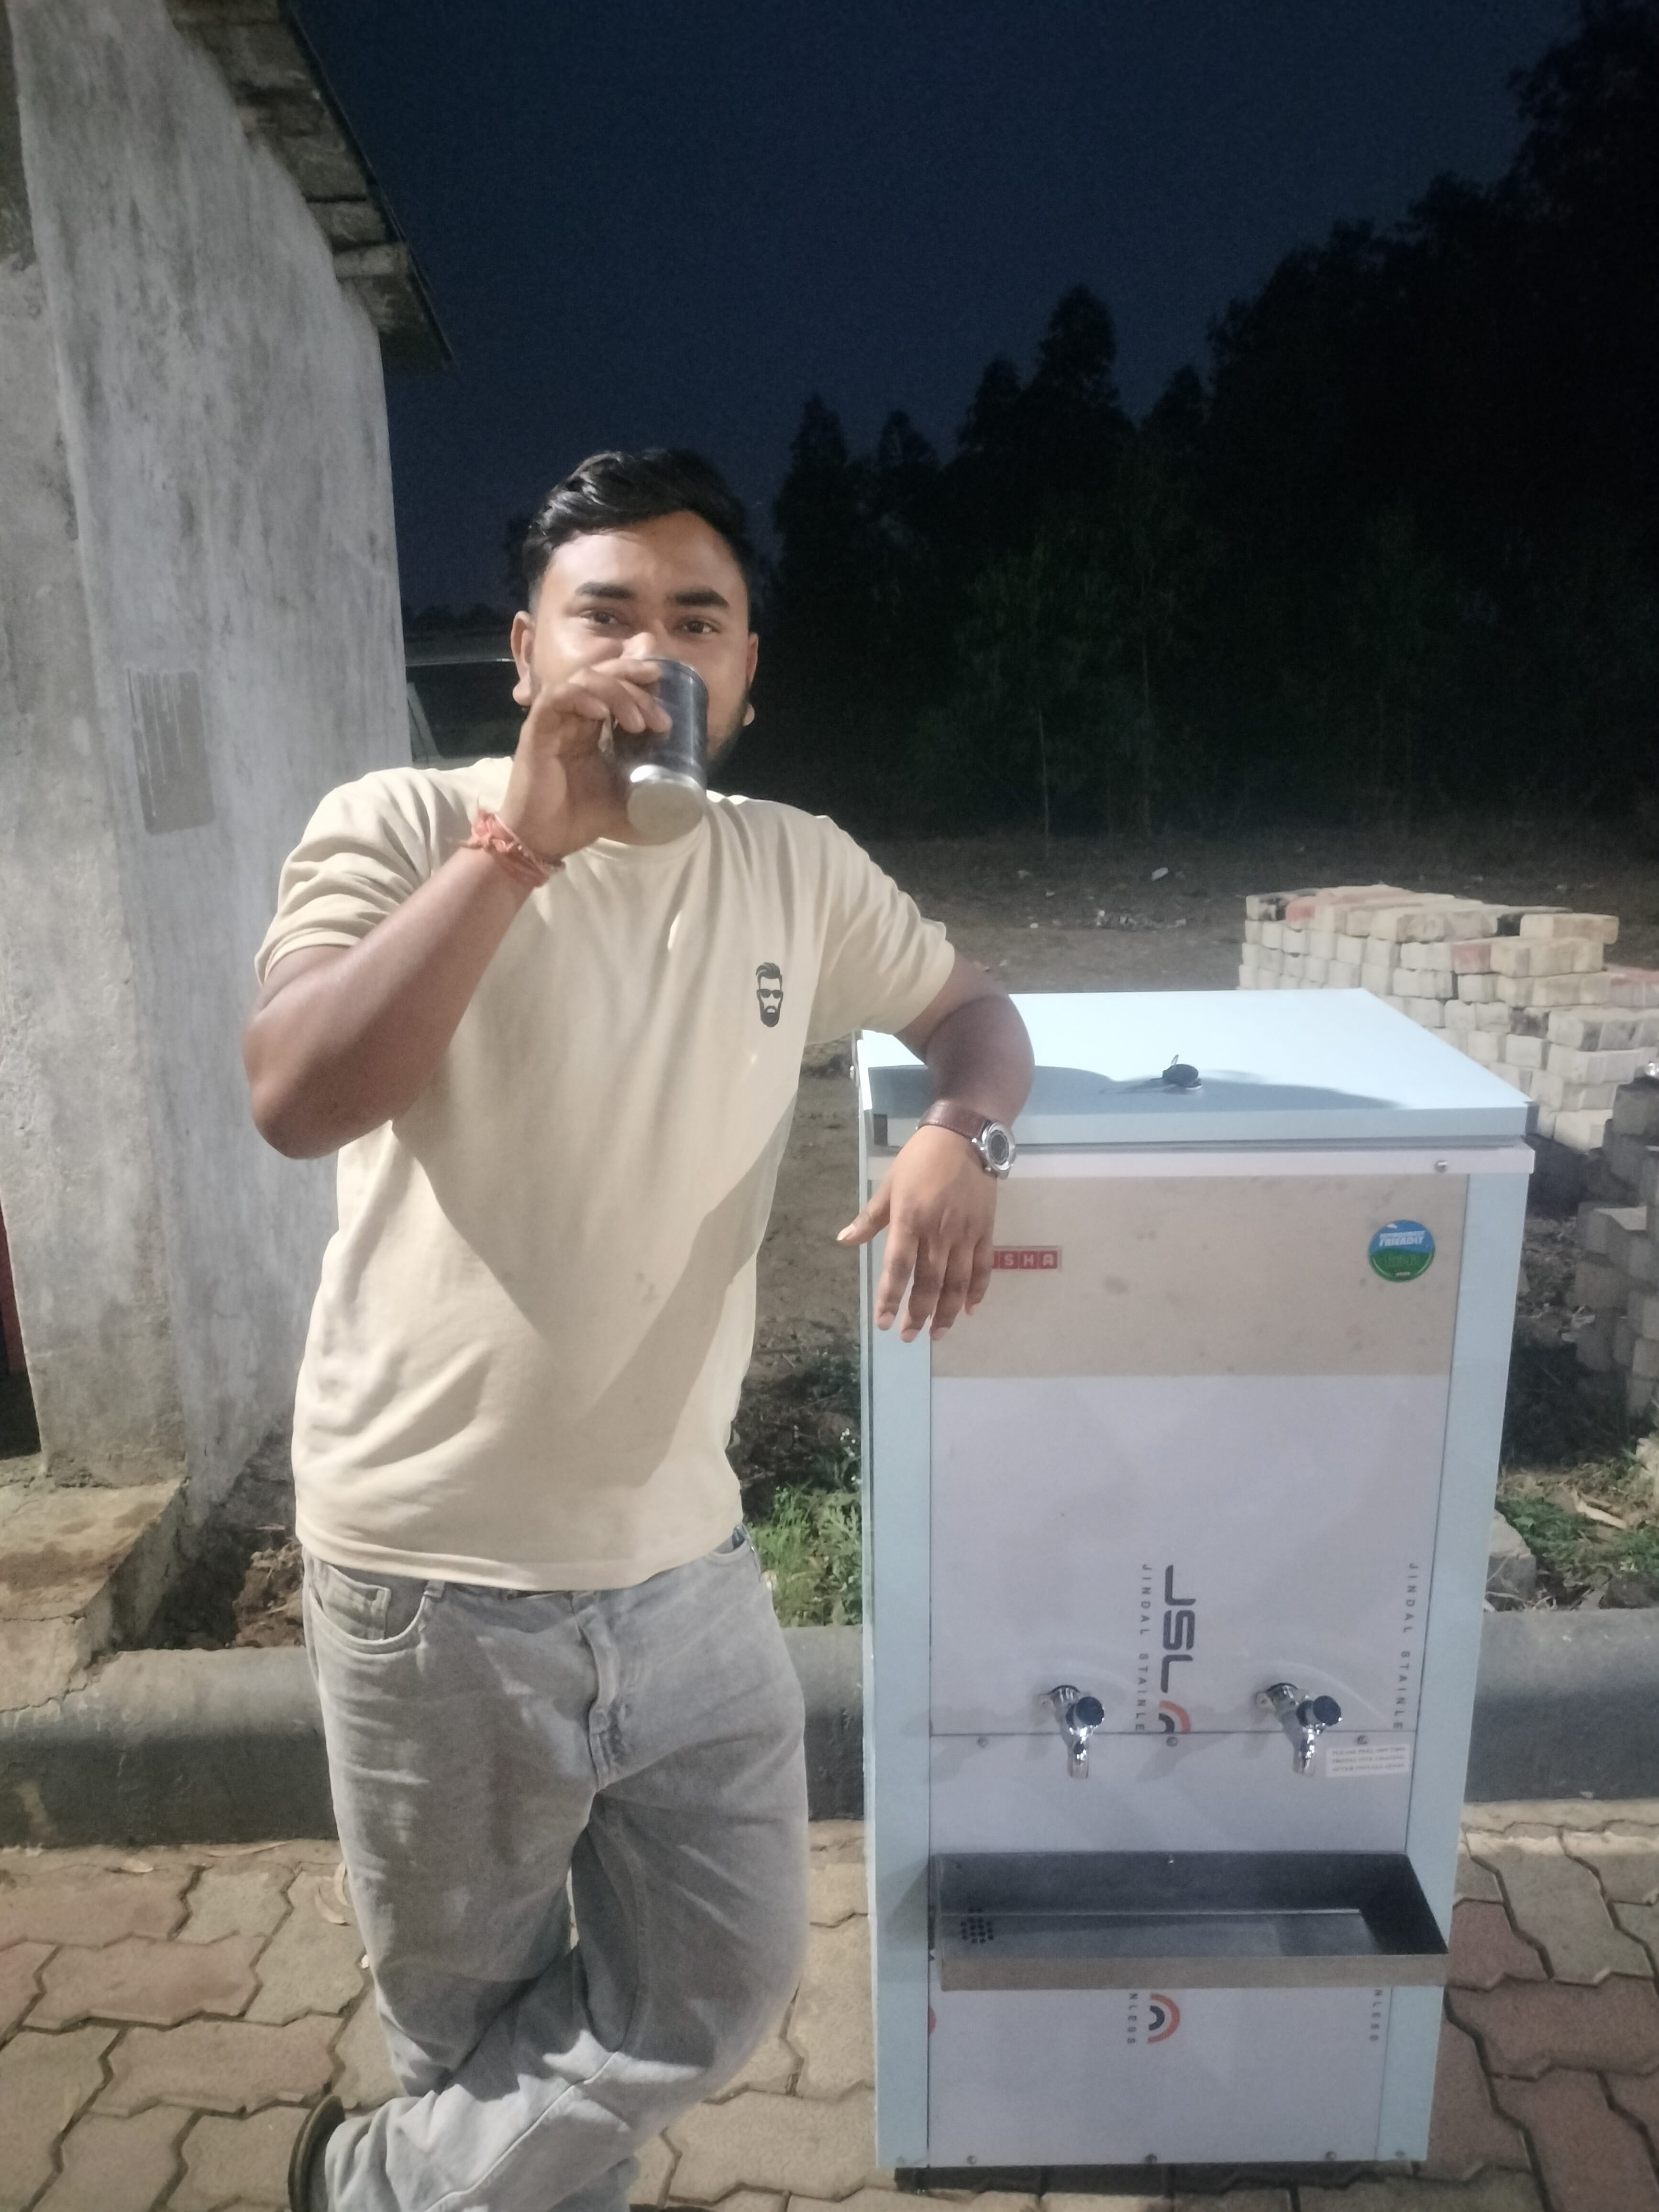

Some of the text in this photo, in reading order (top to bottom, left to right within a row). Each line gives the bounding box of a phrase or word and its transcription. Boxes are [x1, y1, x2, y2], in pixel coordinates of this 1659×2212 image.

[1002, 1252, 1055, 1267] SHA
[1140, 1563, 1152, 1635] JINDAL
[1160, 1564, 1197, 1693] JSL
[1403, 1562, 1419, 1633] JINDAL
